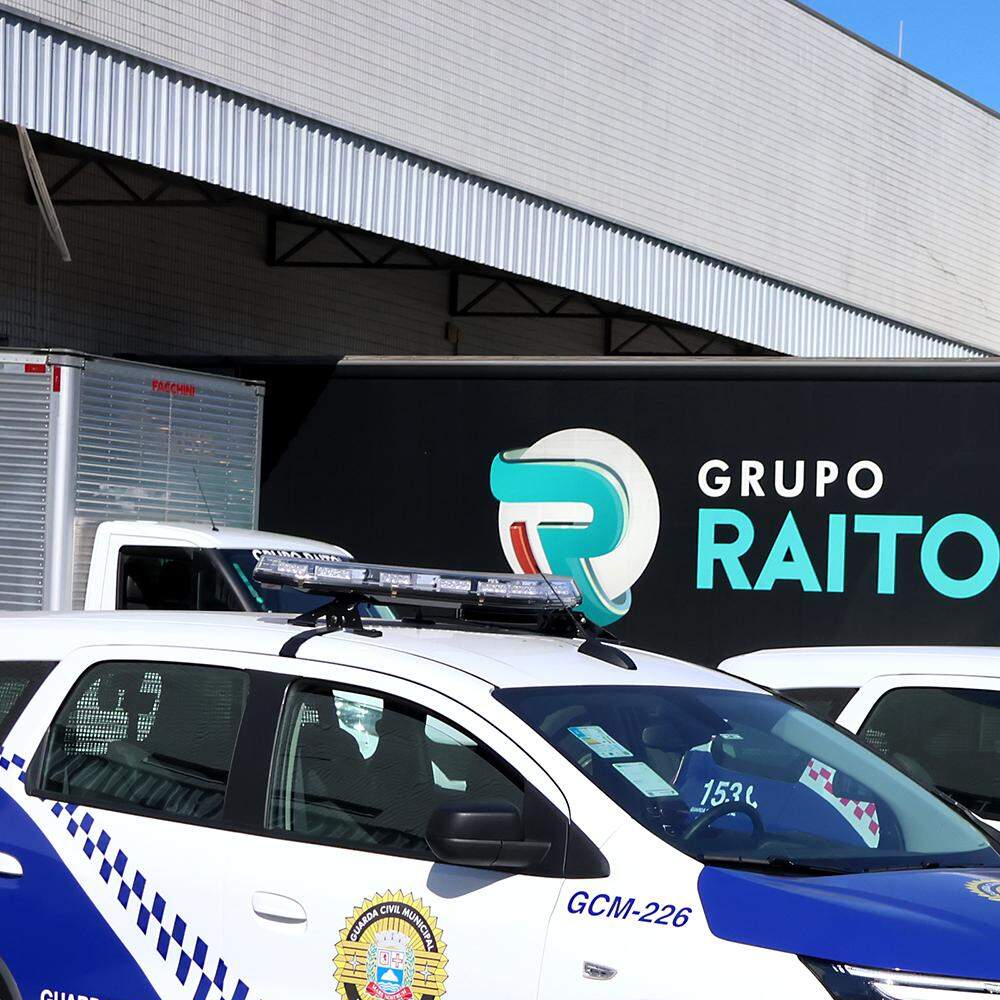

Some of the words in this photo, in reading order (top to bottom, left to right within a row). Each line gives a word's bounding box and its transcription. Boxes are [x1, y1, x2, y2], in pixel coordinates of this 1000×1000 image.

[698, 459, 883, 498] GRUPO
[350, 909, 379, 941] GUARDA
[380, 905, 401, 914] CIVIL
[402, 909, 434, 952] MUNICIPAL
[567, 891, 692, 927] GCM-226
